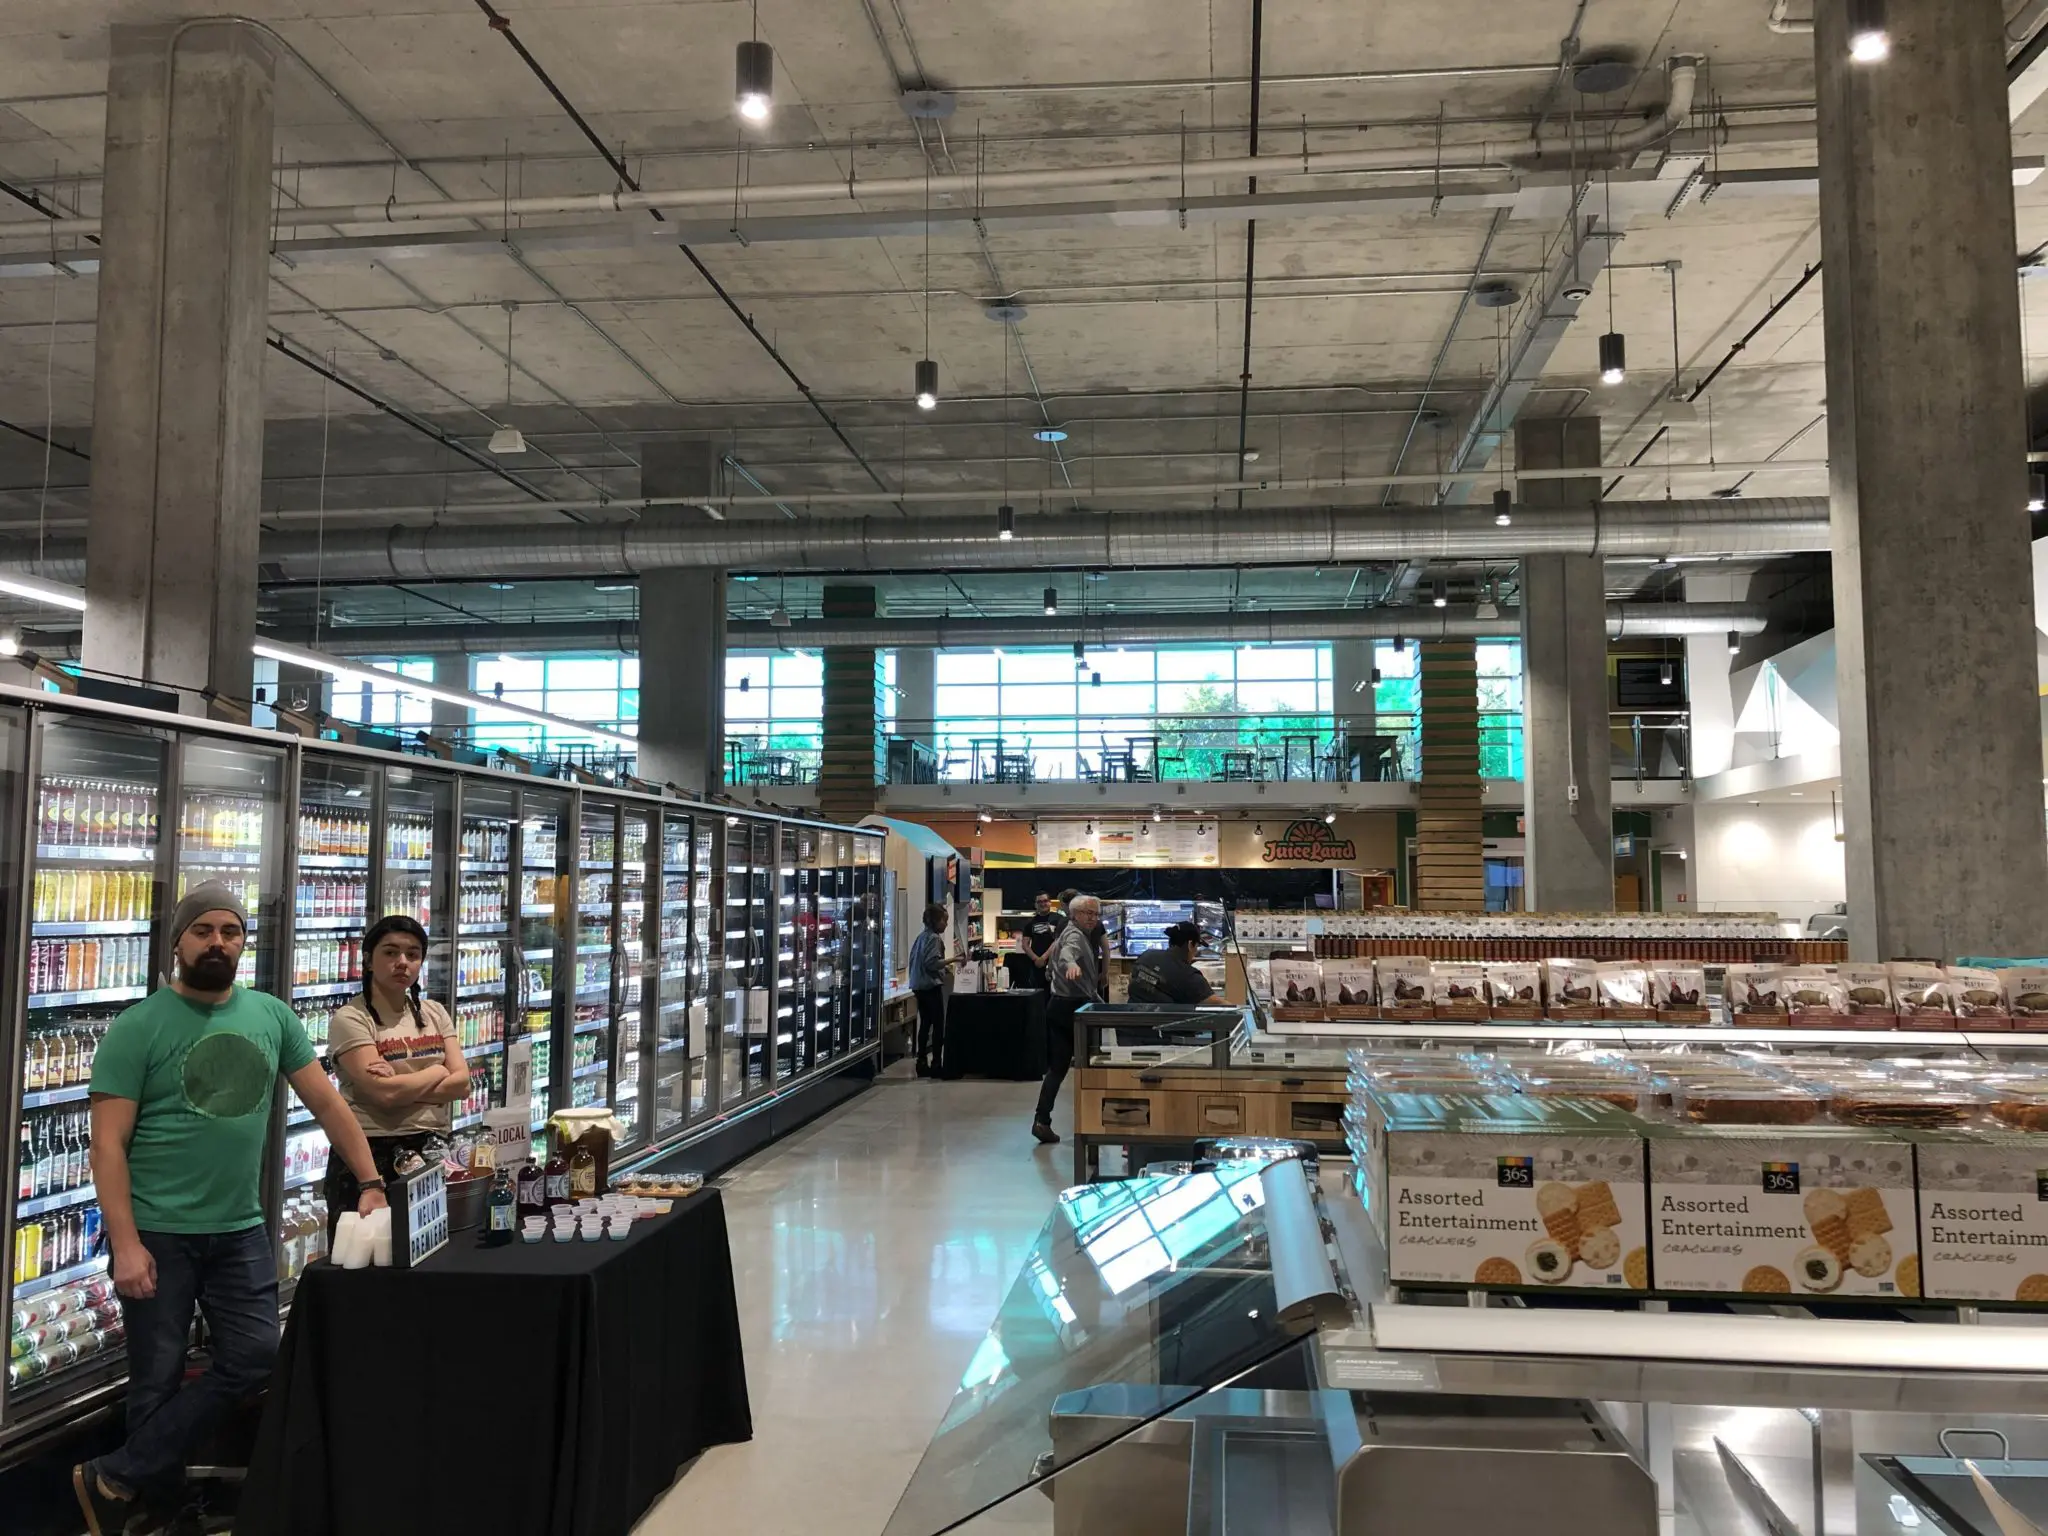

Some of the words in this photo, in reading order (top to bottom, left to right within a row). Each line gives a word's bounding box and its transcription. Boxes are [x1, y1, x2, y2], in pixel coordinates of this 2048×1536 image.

[1262, 840, 1356, 862] JuiceLand
[498, 1126, 526, 1144] LOCAL
[1502, 1167, 1528, 1183] 365
[1767, 1173, 1794, 1189] 365
[416, 1171, 439, 1202] MAGIC
[1398, 1188, 1484, 1207] Assorted
[1660, 1195, 1749, 1214] Assorted
[417, 1198, 440, 1229] MELON
[1398, 1211, 1538, 1232] Entertainment
[1929, 1202, 2024, 1222] Assorted
[1661, 1218, 1807, 1239] Entertainment
[411, 1219, 447, 1262] PREMIERE
[1398, 1235, 1477, 1248] CRACKERS
[1662, 1242, 1743, 1256] CRACKERS
[1932, 1251, 2018, 1265] CRACKERS
